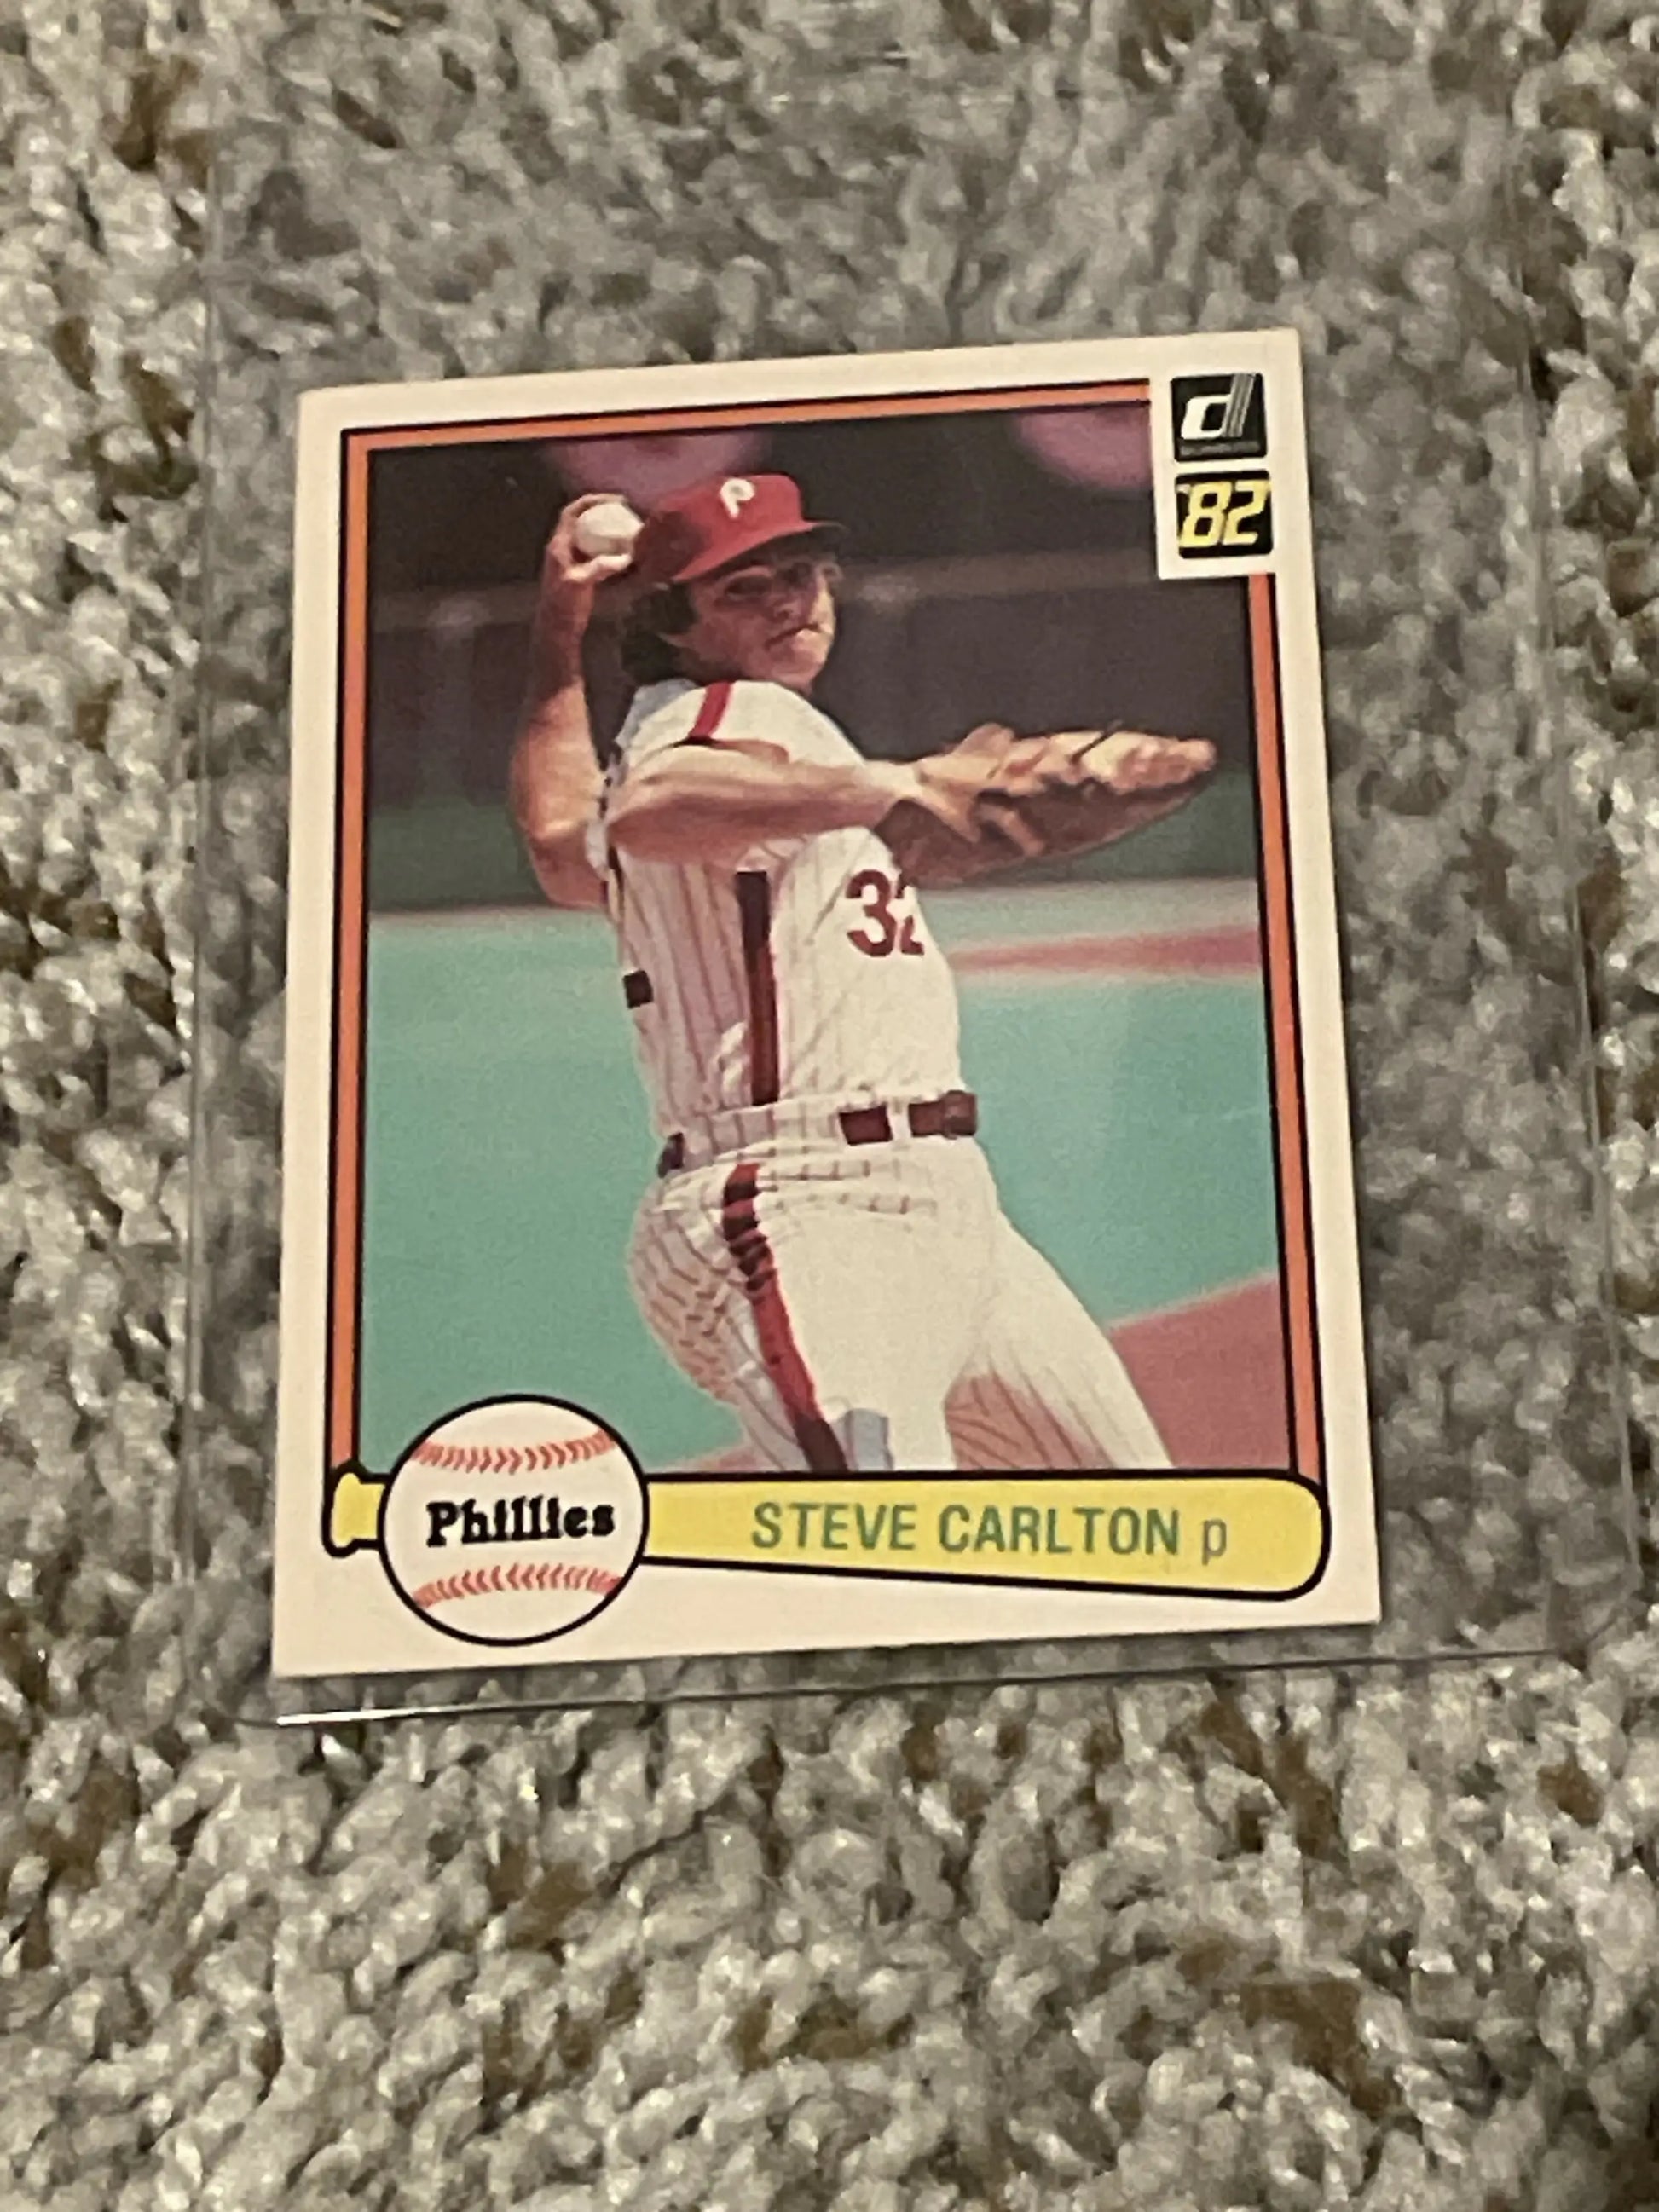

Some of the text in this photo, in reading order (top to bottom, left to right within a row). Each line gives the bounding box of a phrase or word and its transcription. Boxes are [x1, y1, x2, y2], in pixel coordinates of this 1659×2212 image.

[720, 477, 755, 519] P
[426, 1496, 615, 1547] Phillies
[752, 1501, 1227, 1566] STEVE CARLTON p
